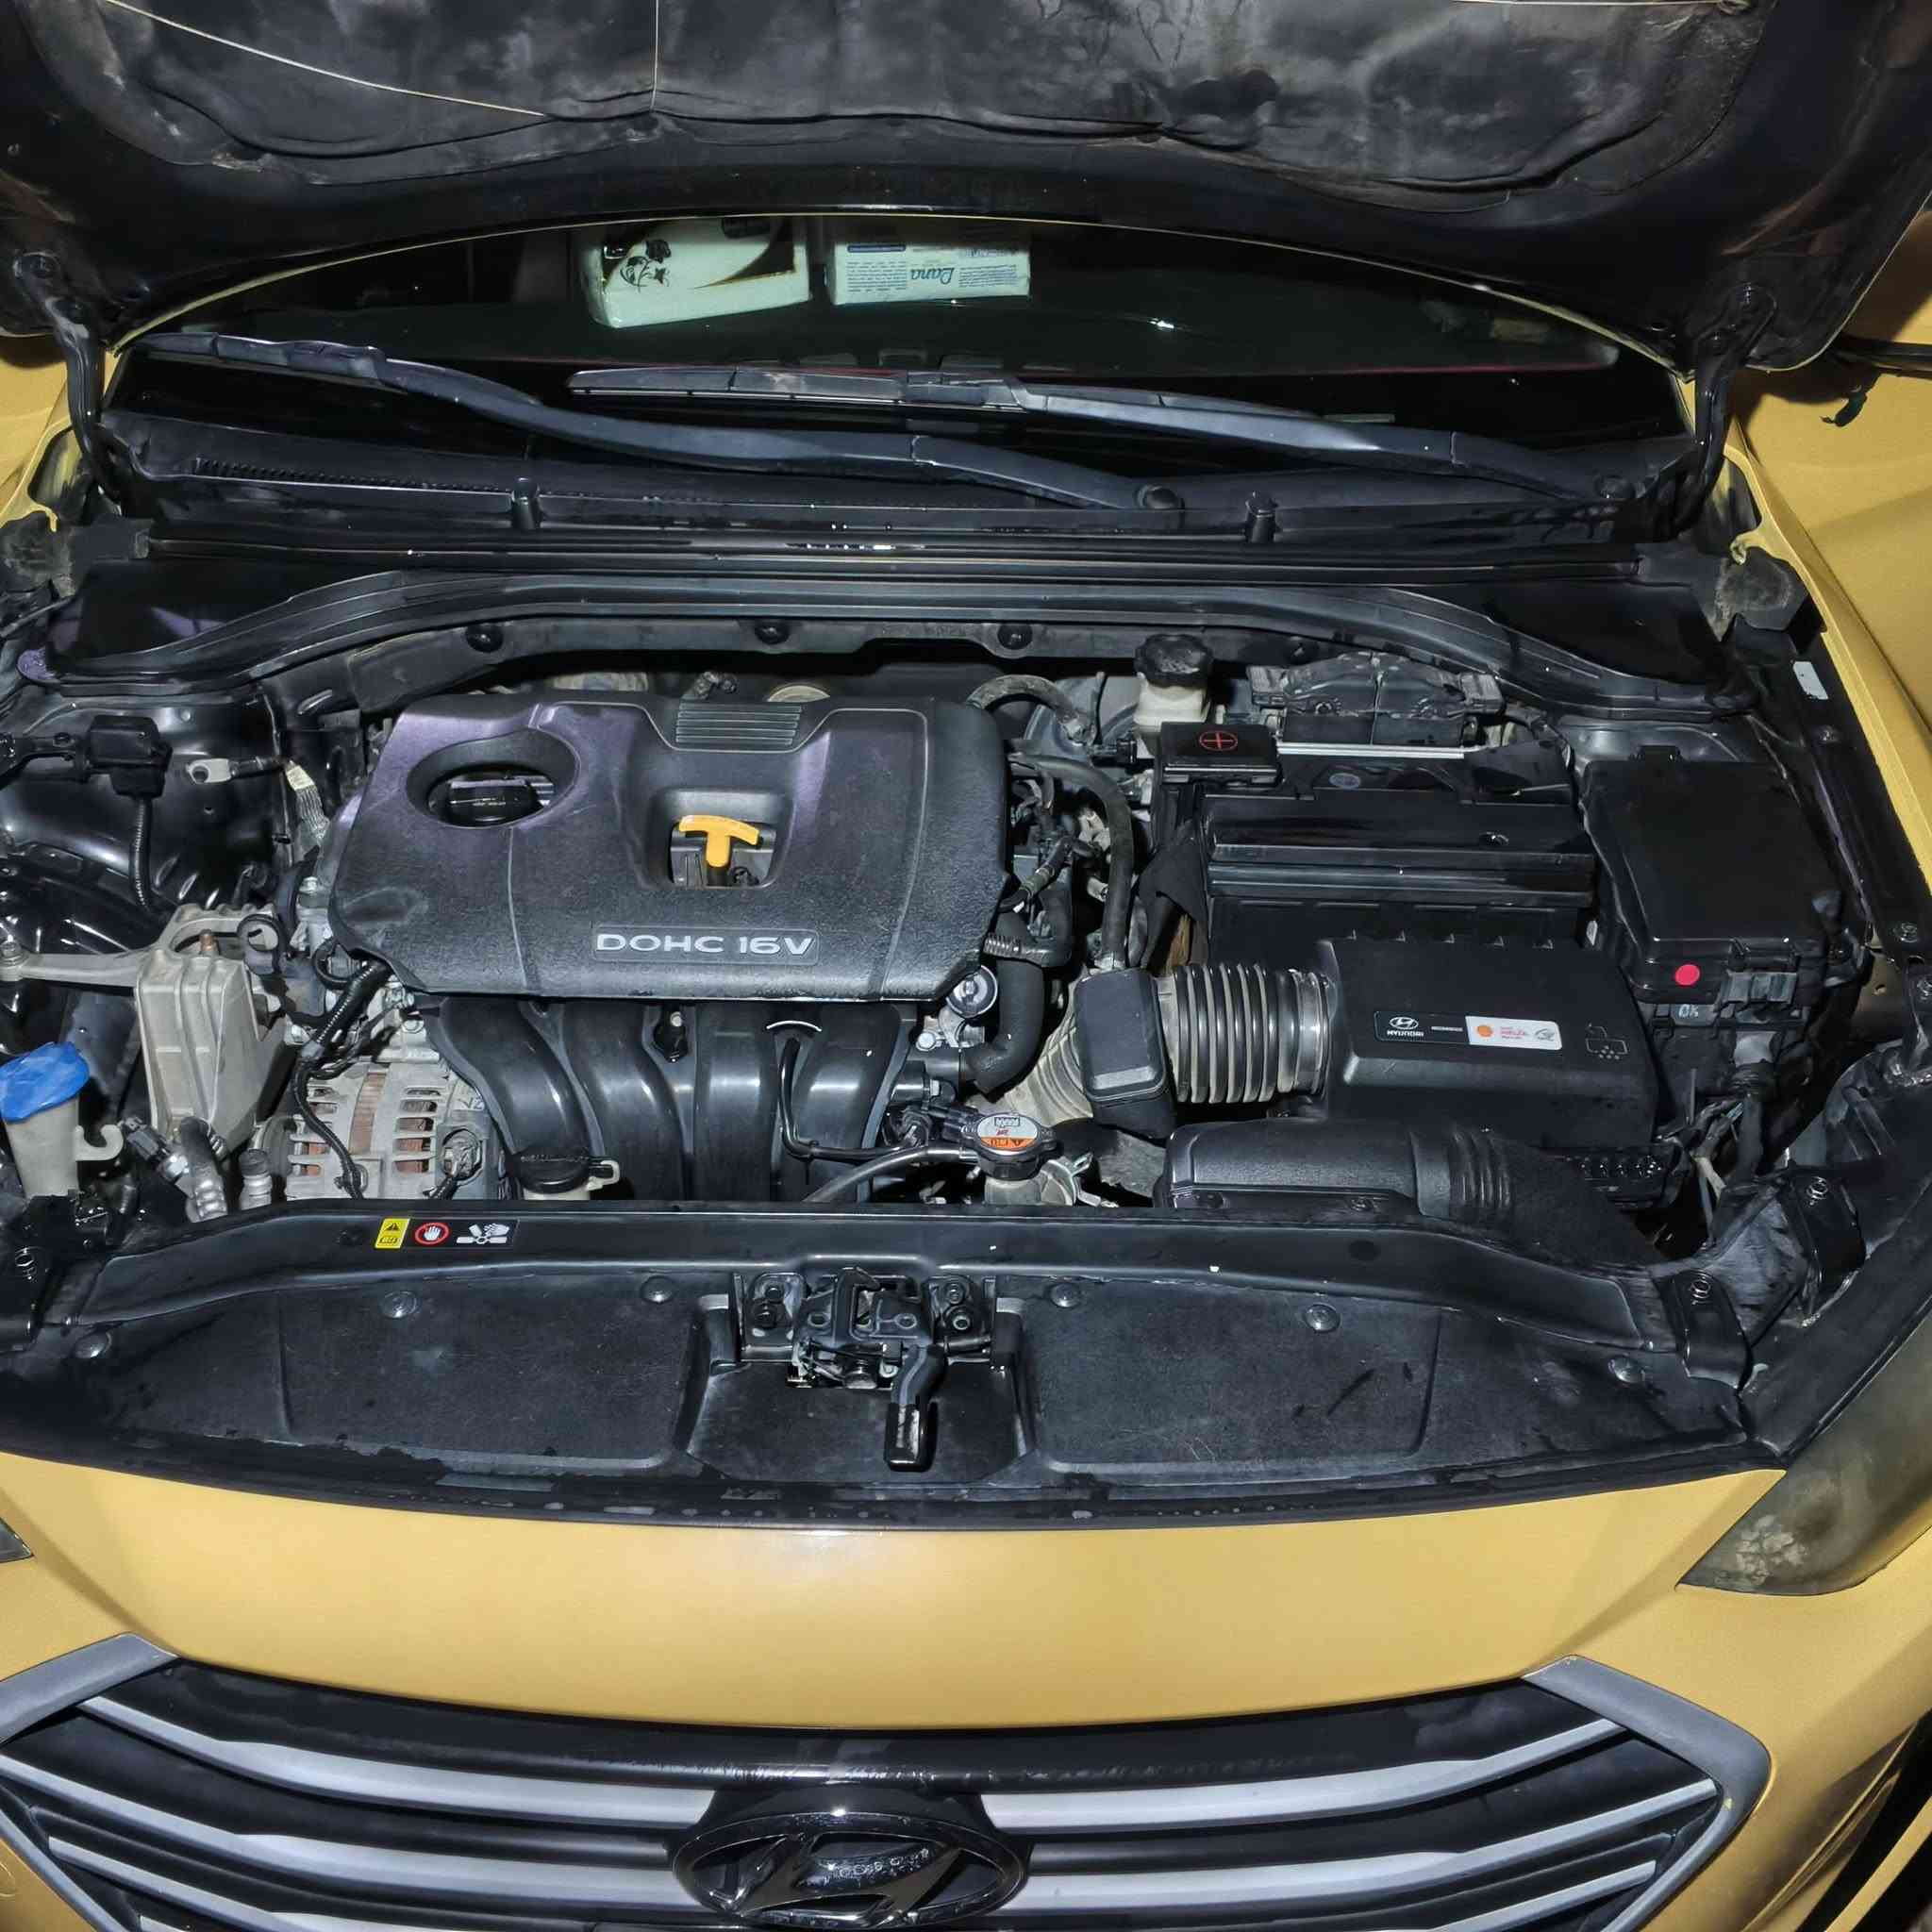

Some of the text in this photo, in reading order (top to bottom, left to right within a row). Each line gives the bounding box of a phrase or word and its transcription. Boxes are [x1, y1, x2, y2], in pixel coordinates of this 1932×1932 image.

[596, 934, 814, 955] DOHC 16V
[1387, 1029, 1424, 1038] HYUNDAI
